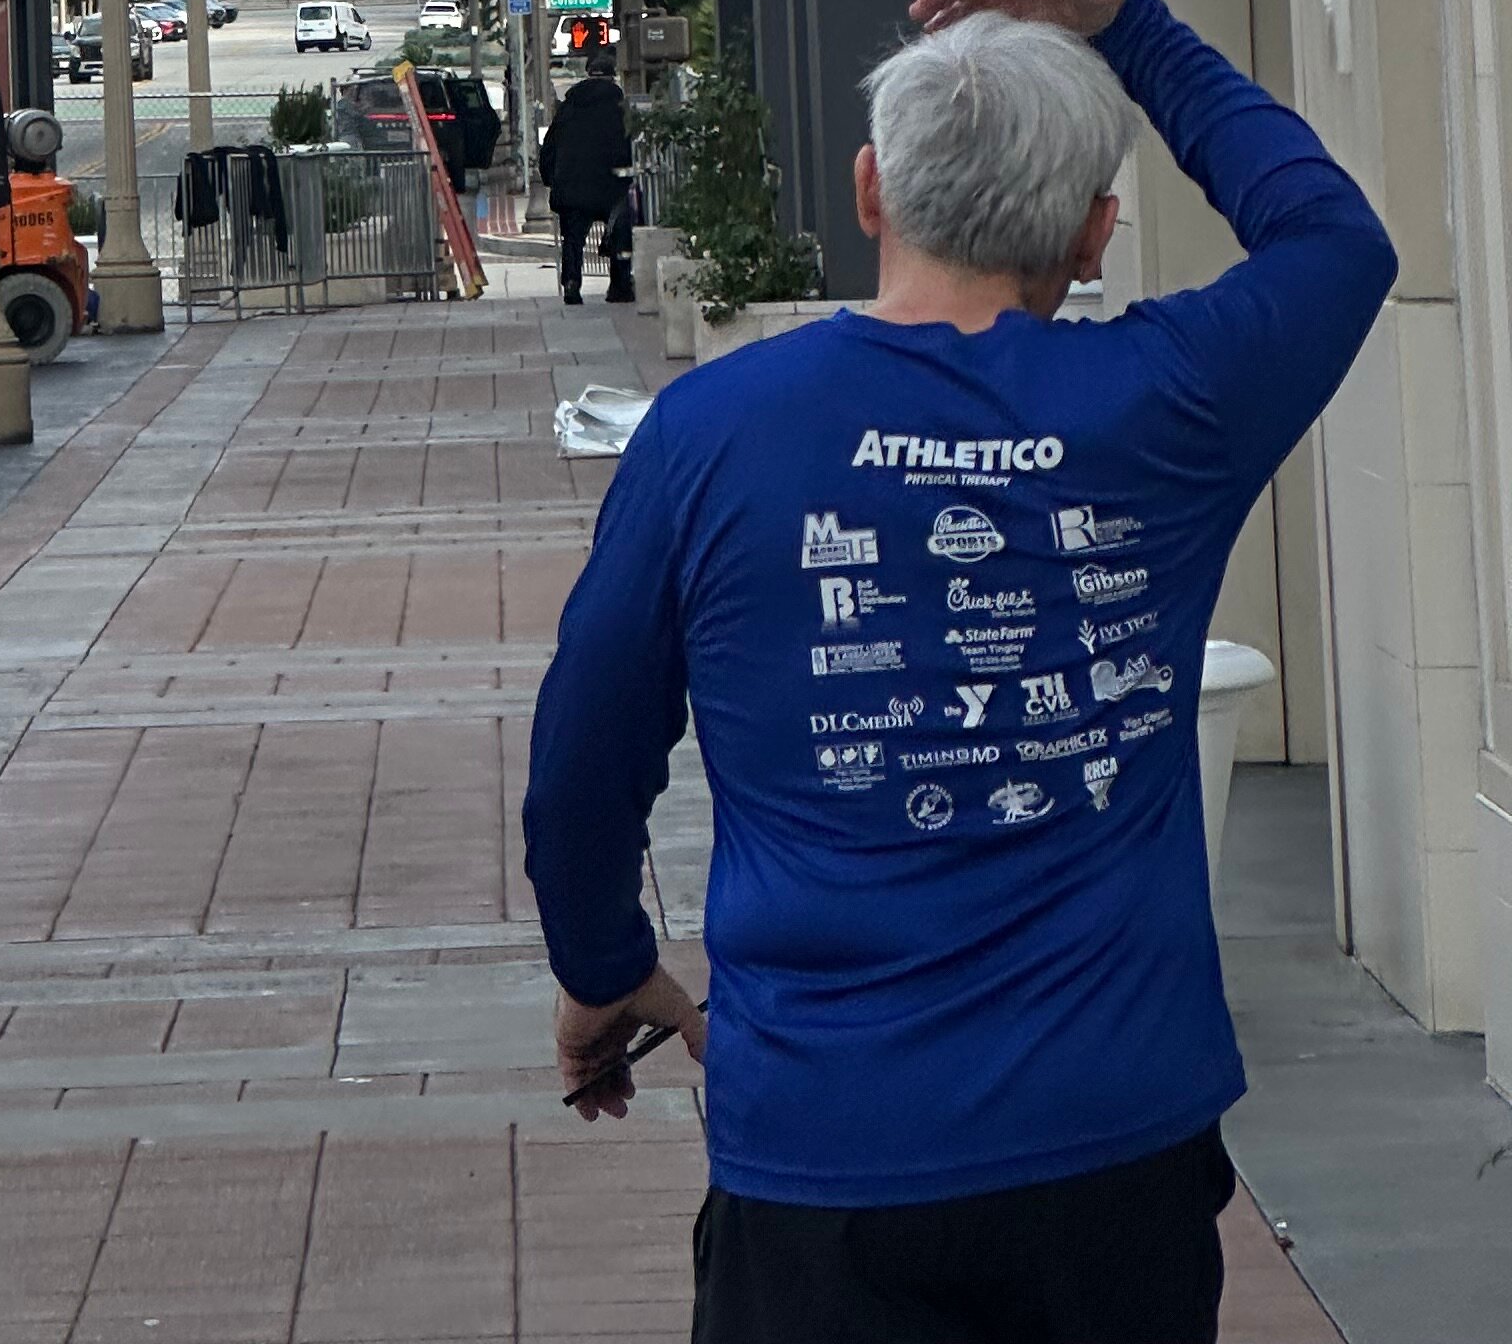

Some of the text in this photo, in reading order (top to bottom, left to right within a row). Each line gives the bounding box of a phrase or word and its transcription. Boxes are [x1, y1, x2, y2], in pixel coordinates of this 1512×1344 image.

[851, 429, 1064, 472] ATHLETICO
[904, 472, 1012, 487] PHYSICAL THERAPY
[935, 535, 999, 550] SPORTS
[1079, 568, 1148, 594] Gibson
[1025, 693, 1072, 714] CVB
[1084, 757, 1118, 781] RRCA
